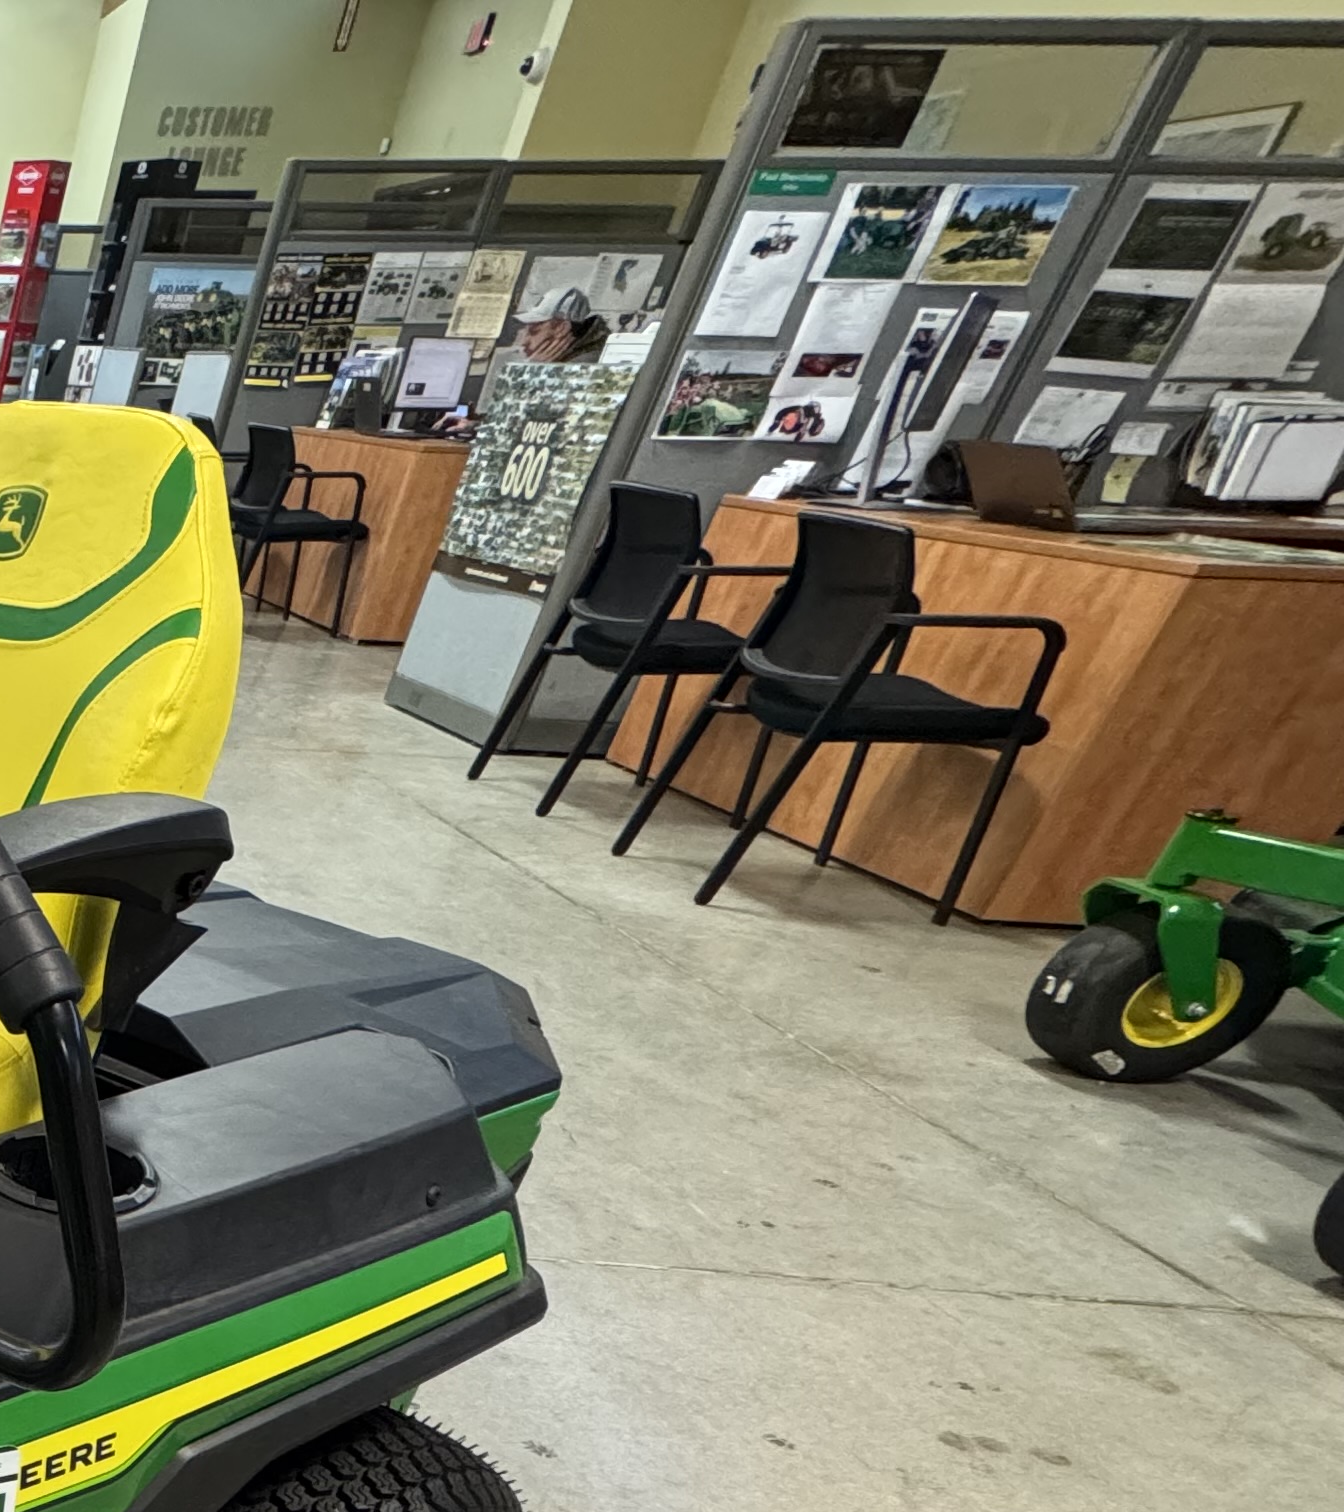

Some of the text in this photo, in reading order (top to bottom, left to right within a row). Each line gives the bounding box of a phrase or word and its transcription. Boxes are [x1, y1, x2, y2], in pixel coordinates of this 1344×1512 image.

[157, 106, 273, 137] CUSTOMER
[522, 421, 557, 444] over
[500, 444, 550, 499] 600
[20, 1432, 117, 1491] EERE
